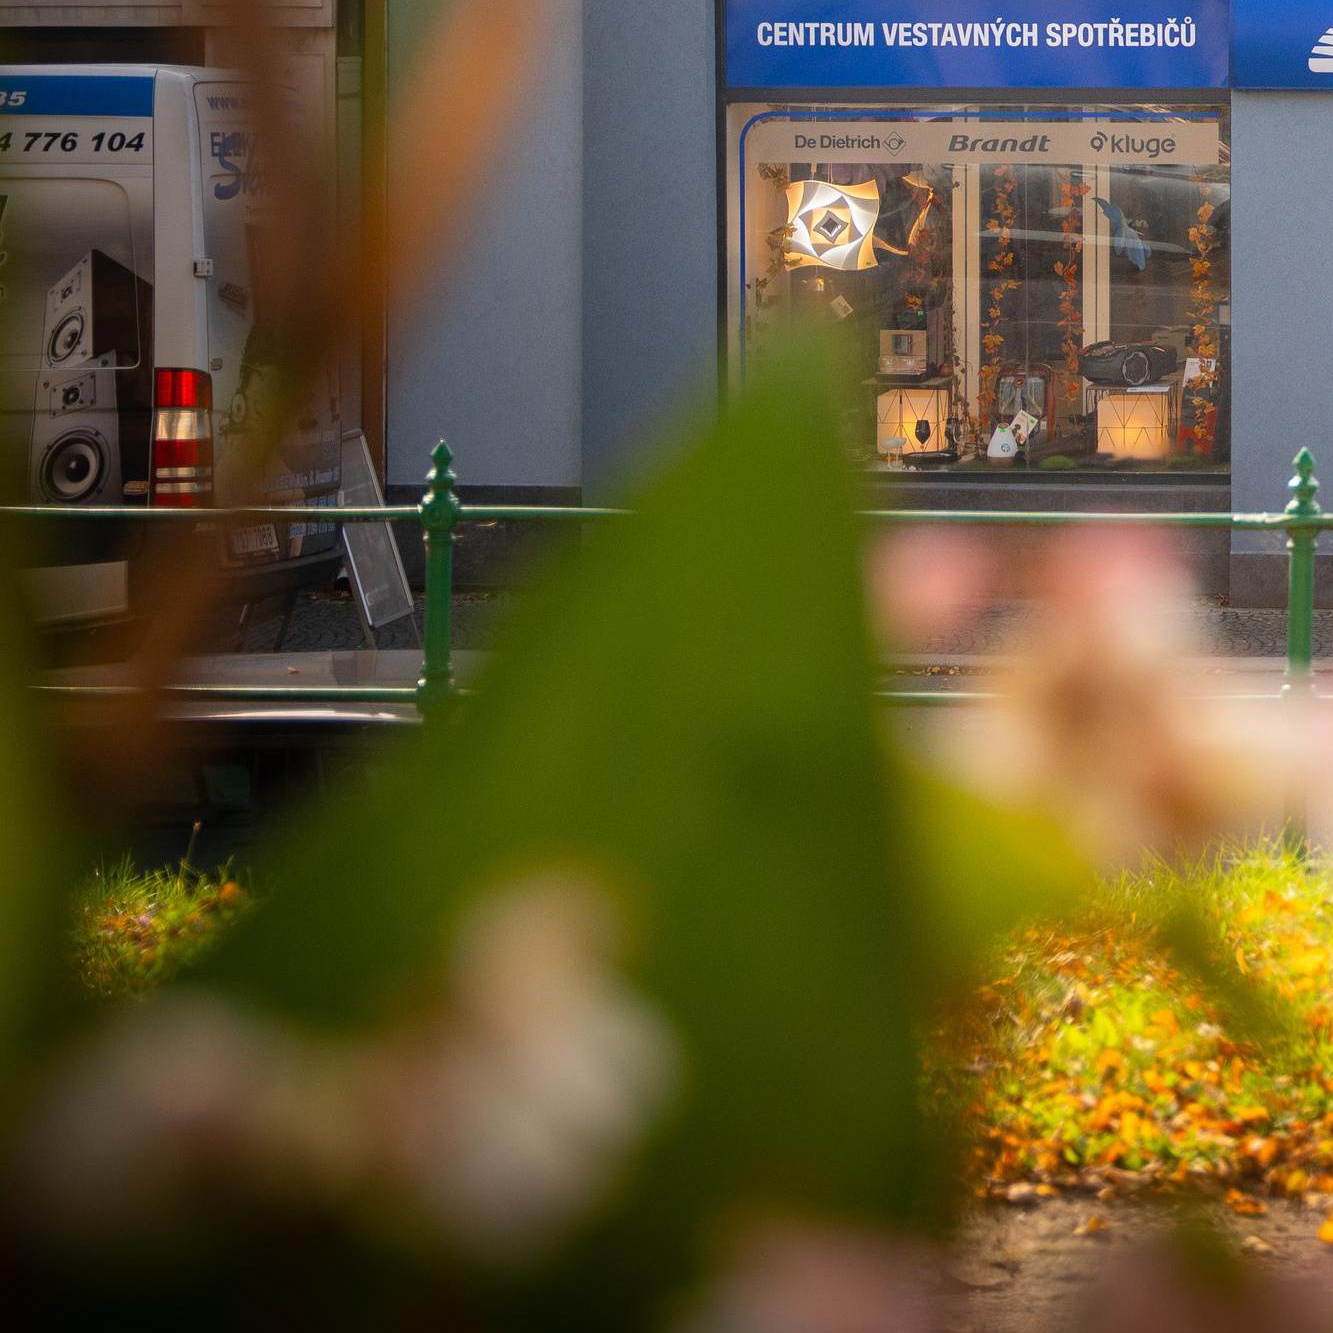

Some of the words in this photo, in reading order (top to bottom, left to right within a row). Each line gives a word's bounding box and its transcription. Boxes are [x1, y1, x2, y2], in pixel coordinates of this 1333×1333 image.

[757, 22, 875, 47] CENTRUM
[882, 17, 1038, 47] VESTAVNÝCH
[1046, 16, 1196, 47] SPOTŘEBIČŮ
[23, 132, 79, 152] 776
[91, 132, 145, 152] 104
[795, 135, 817, 149] De
[820, 135, 881, 149] Dietrich
[948, 134, 1051, 152] Brandt
[1111, 134, 1176, 158] kluge
